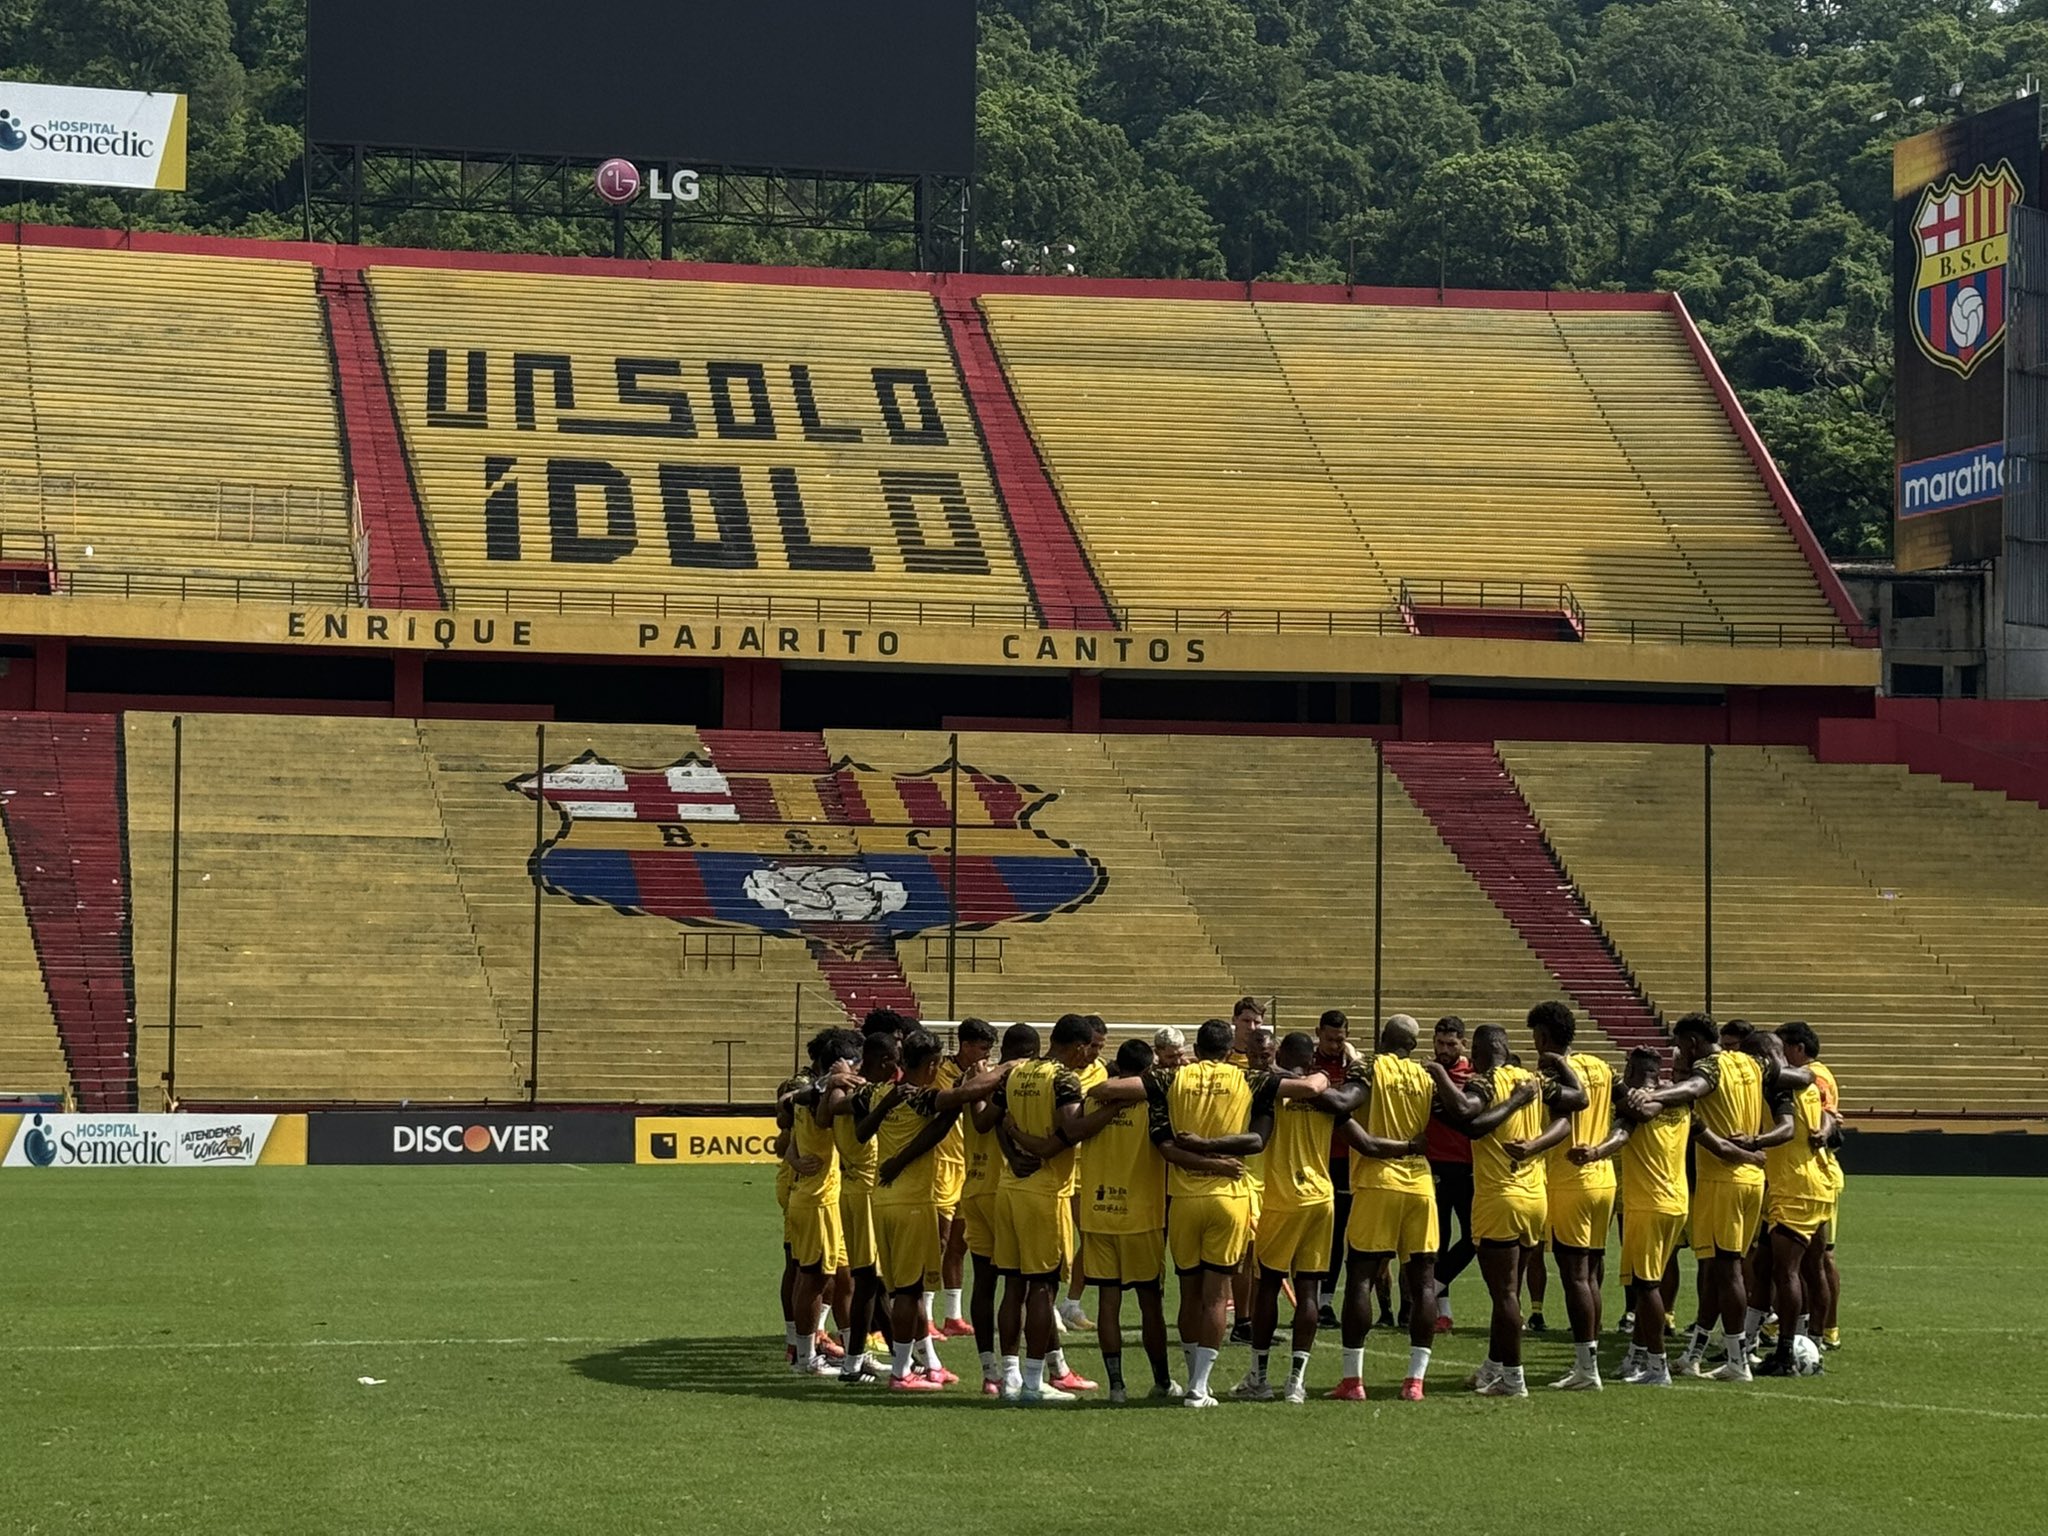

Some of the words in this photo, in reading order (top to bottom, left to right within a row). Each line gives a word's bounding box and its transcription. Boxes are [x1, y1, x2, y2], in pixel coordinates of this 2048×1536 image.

[30, 124, 154, 158] Semedic
[48, 120, 118, 135] HOSPITAL
[649, 168, 700, 201] LG
[288, 611, 532, 649] ENRIQUE
[638, 623, 898, 656] PAJARITO
[1002, 634, 1205, 664] CANTOS
[77, 1123, 140, 1138] HOSPITAL
[393, 1125, 551, 1153] DISCOVER
[60, 1130, 171, 1165] Semedic
